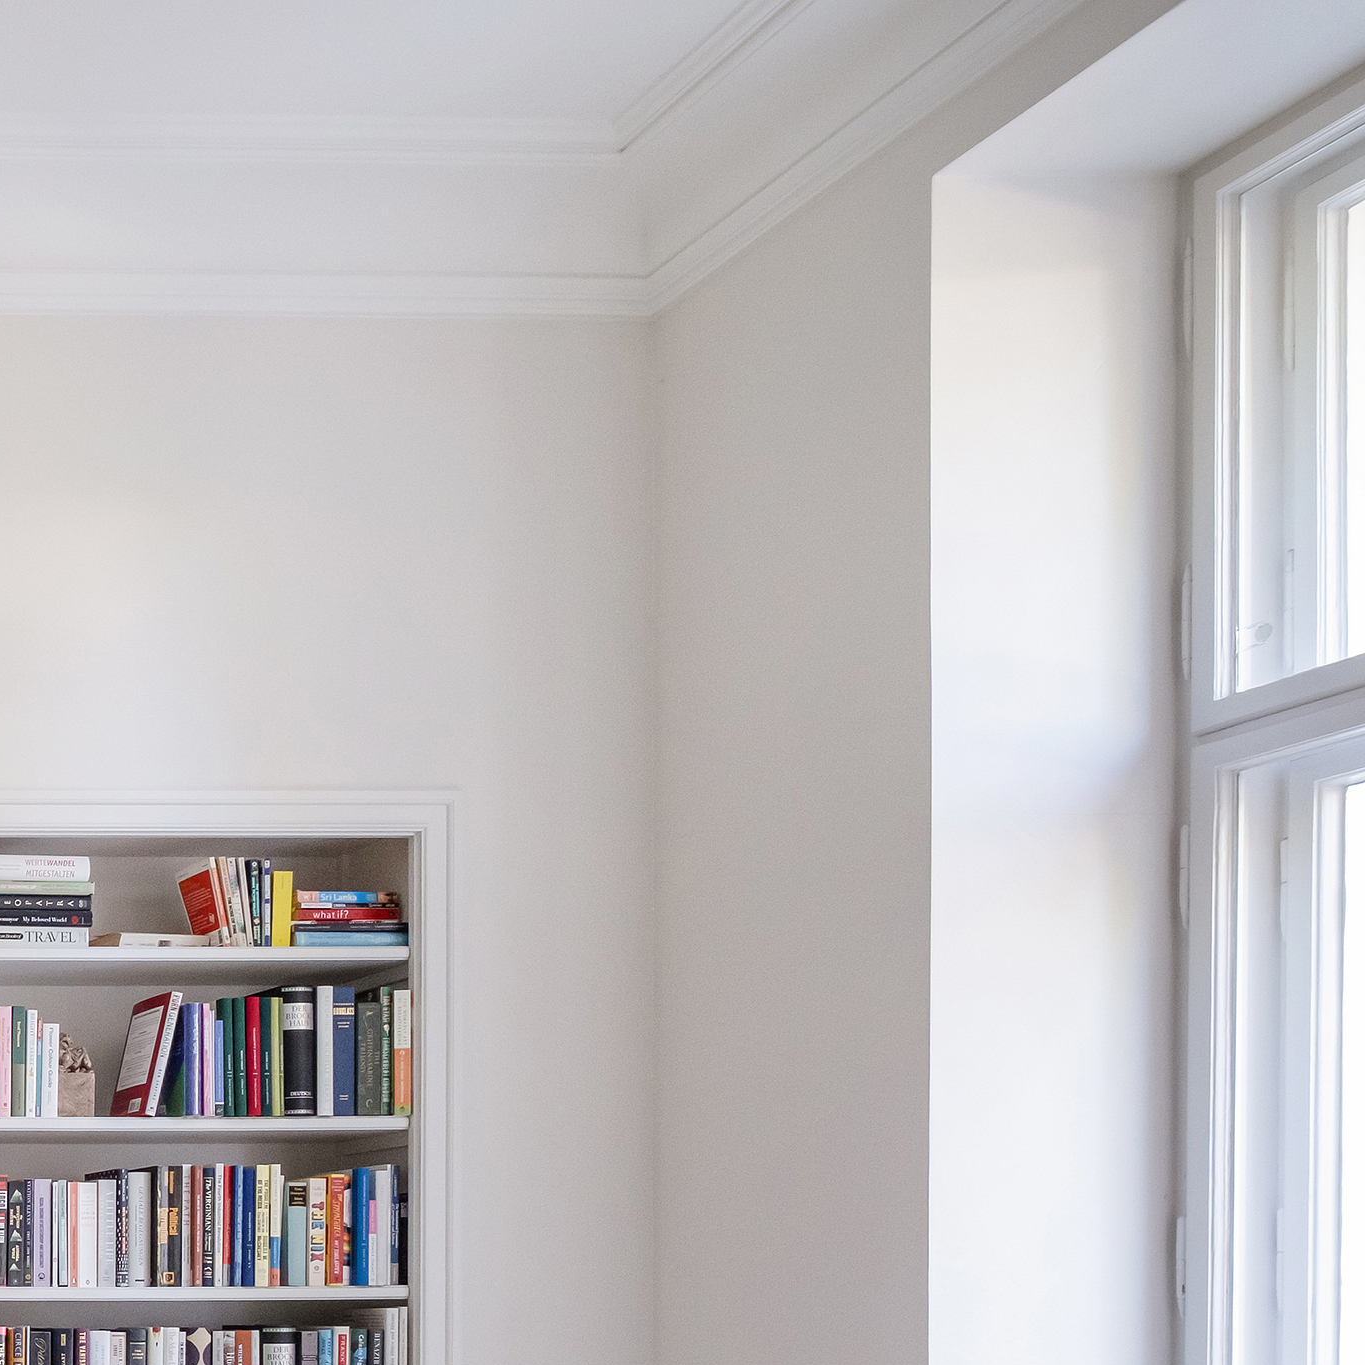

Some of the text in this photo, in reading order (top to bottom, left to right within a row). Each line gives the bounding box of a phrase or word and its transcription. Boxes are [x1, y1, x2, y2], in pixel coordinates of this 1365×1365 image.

[333, 893, 358, 901] Lanka
[336, 910, 350, 918] if?
[25, 931, 77, 943] TRAVEL
[160, 994, 180, 1058] PORN GENERATION
[159, 1207, 168, 1244] Corruption
[168, 1207, 179, 1236] Political
[311, 1202, 324, 1262] THE NIX
[14, 1332, 22, 1357] CIRCE
